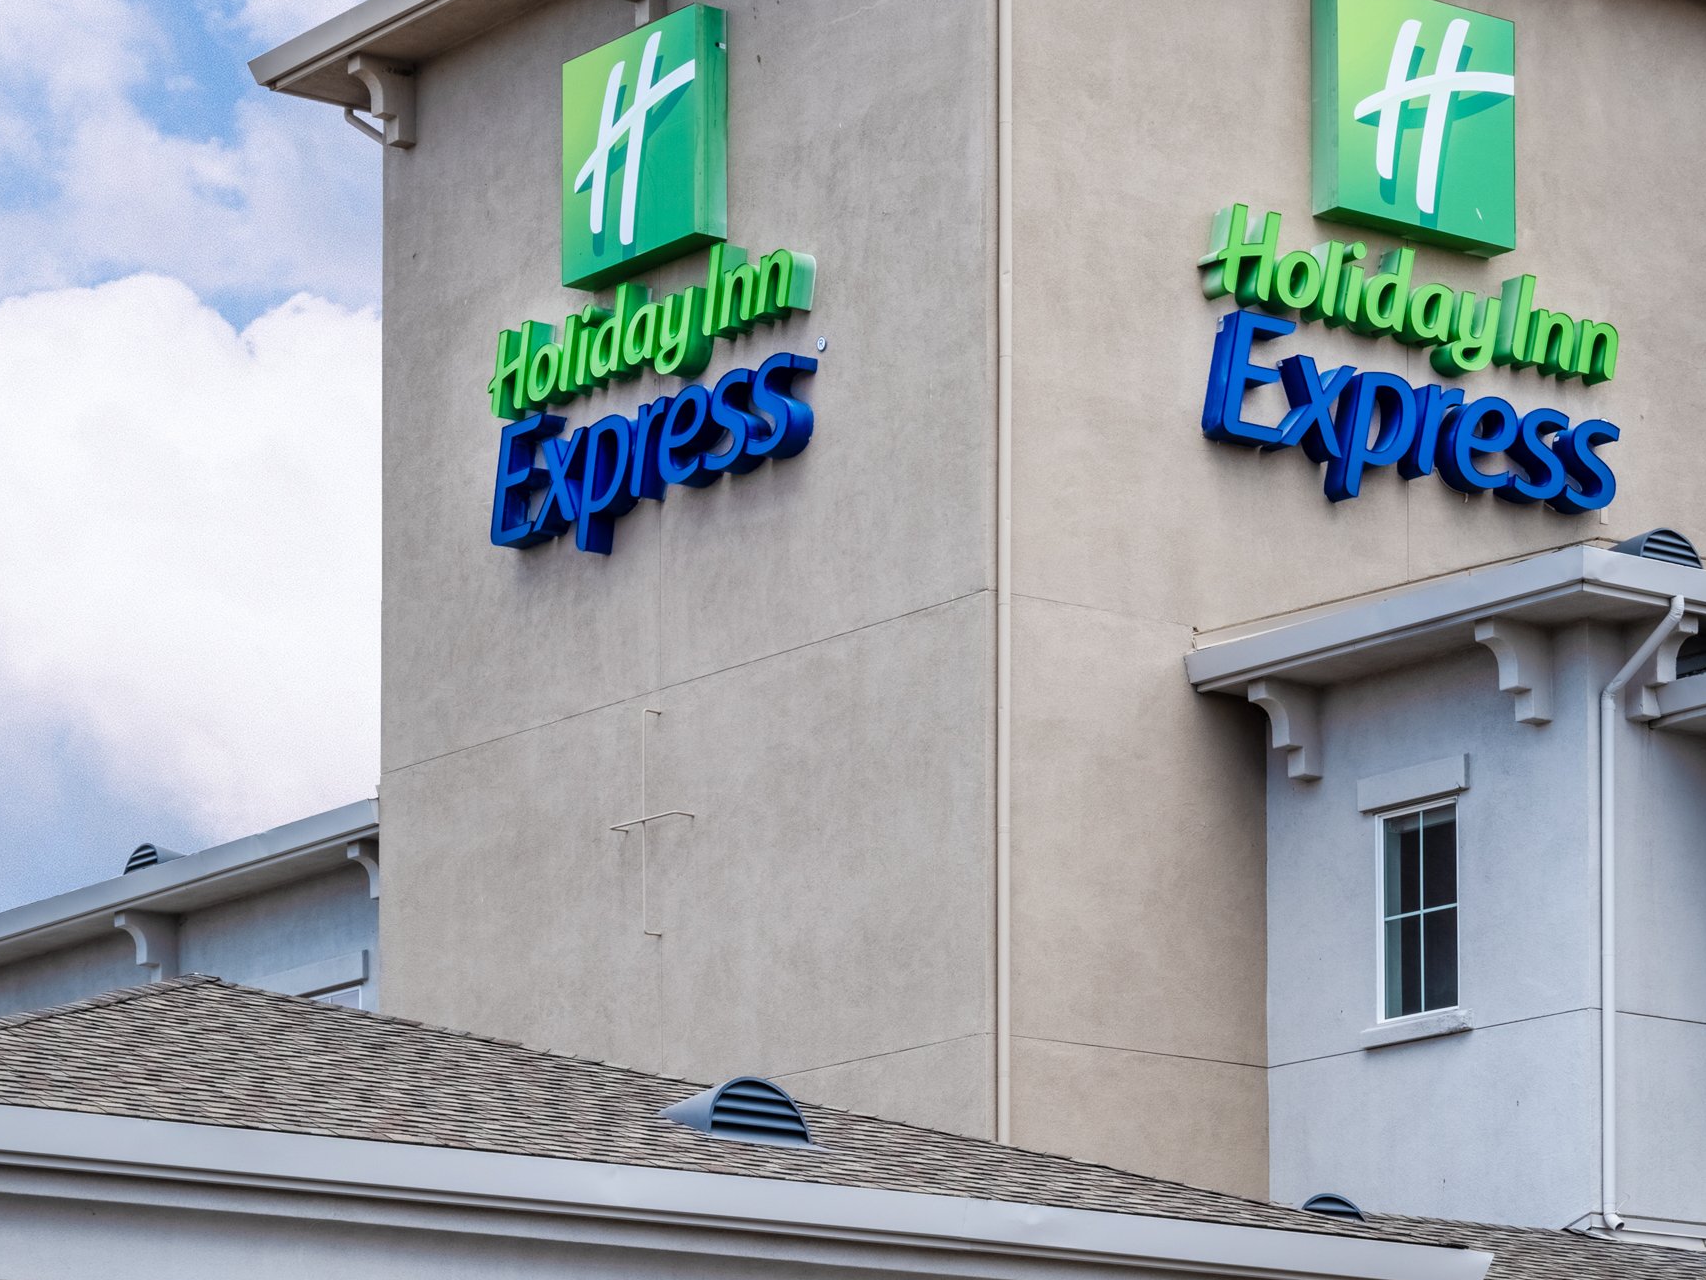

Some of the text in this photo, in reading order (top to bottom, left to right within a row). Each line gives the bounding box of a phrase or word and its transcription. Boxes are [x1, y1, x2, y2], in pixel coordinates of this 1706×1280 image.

[487, 242, 816, 419] Holiday Inn
[1198, 203, 1619, 386] Holiday Inn
[490, 352, 818, 556] Express
[1201, 310, 1621, 516] Express
